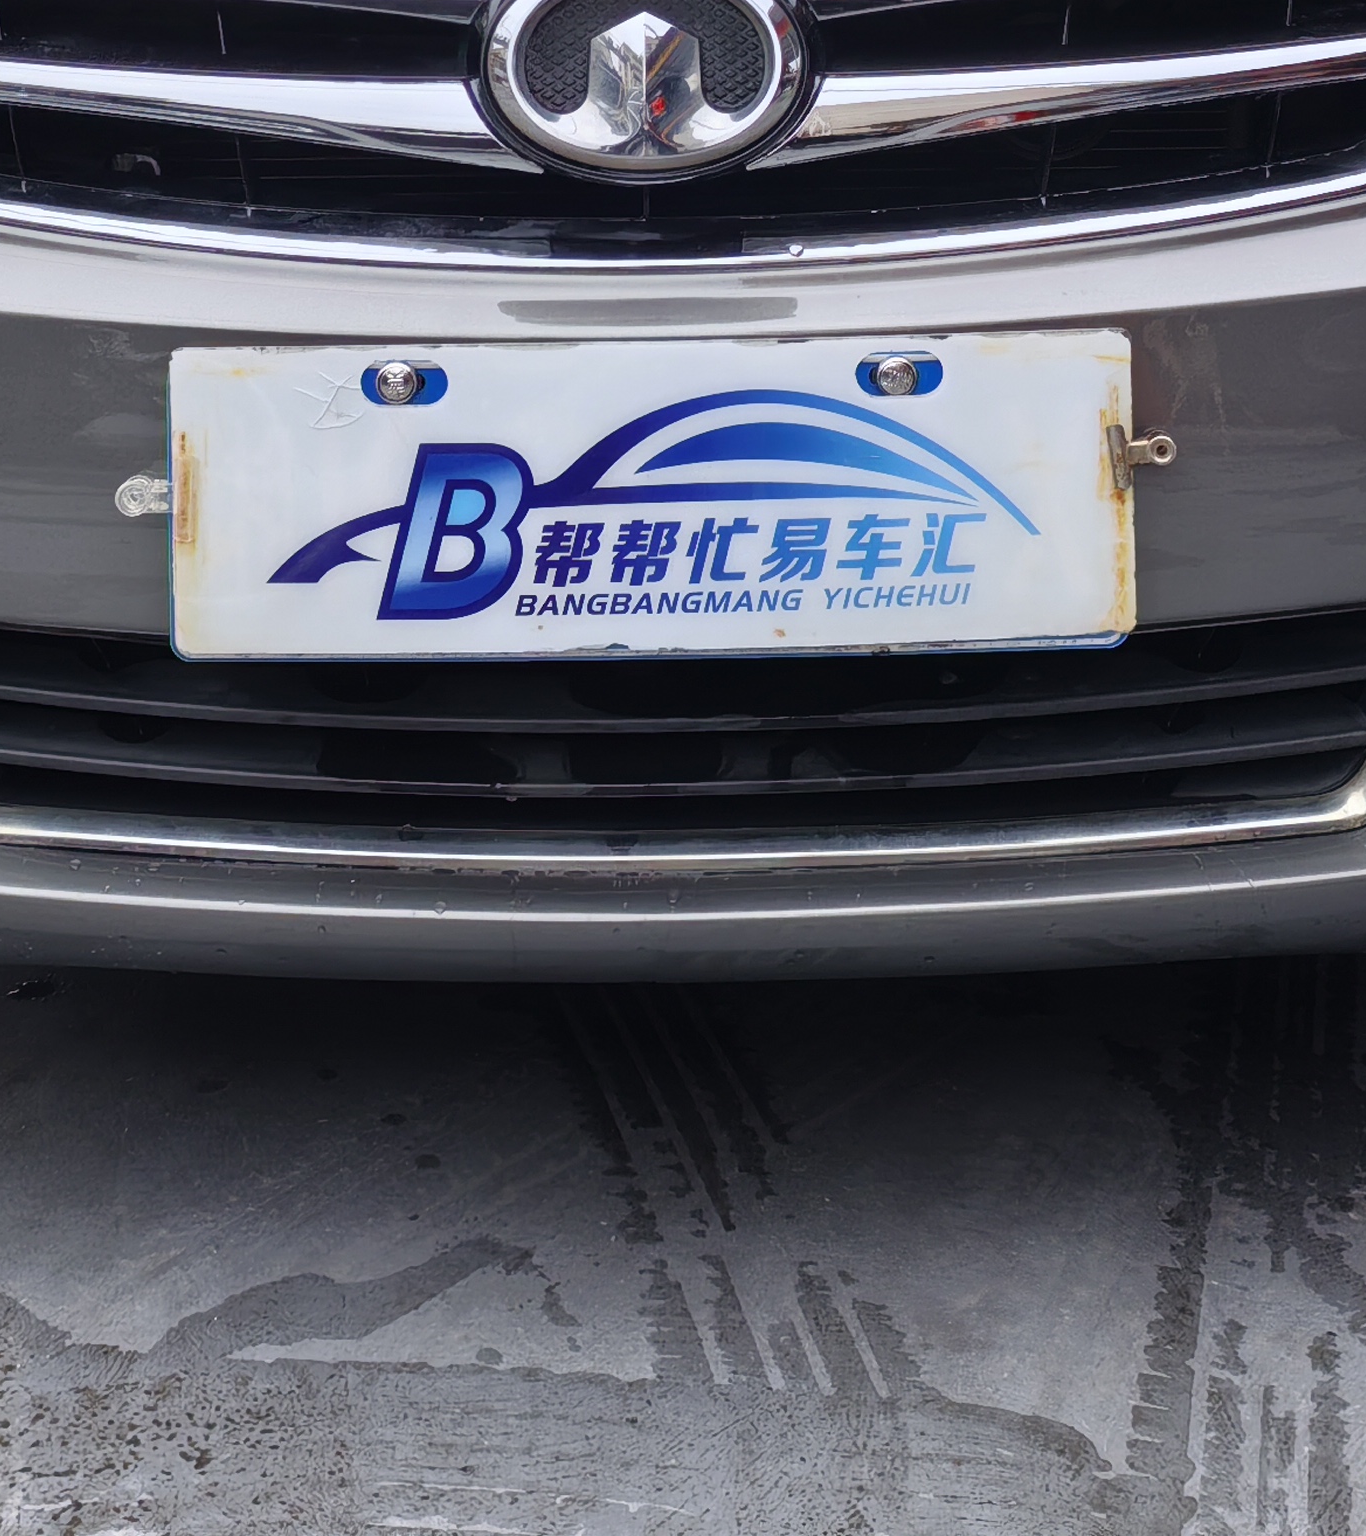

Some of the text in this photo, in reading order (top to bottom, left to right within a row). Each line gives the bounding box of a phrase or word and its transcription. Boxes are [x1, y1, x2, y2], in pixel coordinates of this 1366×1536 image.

[376, 442, 524, 620] B
[533, 512, 987, 587] 帮帮忙易车汇
[514, 581, 973, 617] BANGBANGMANG YICHEHUI
